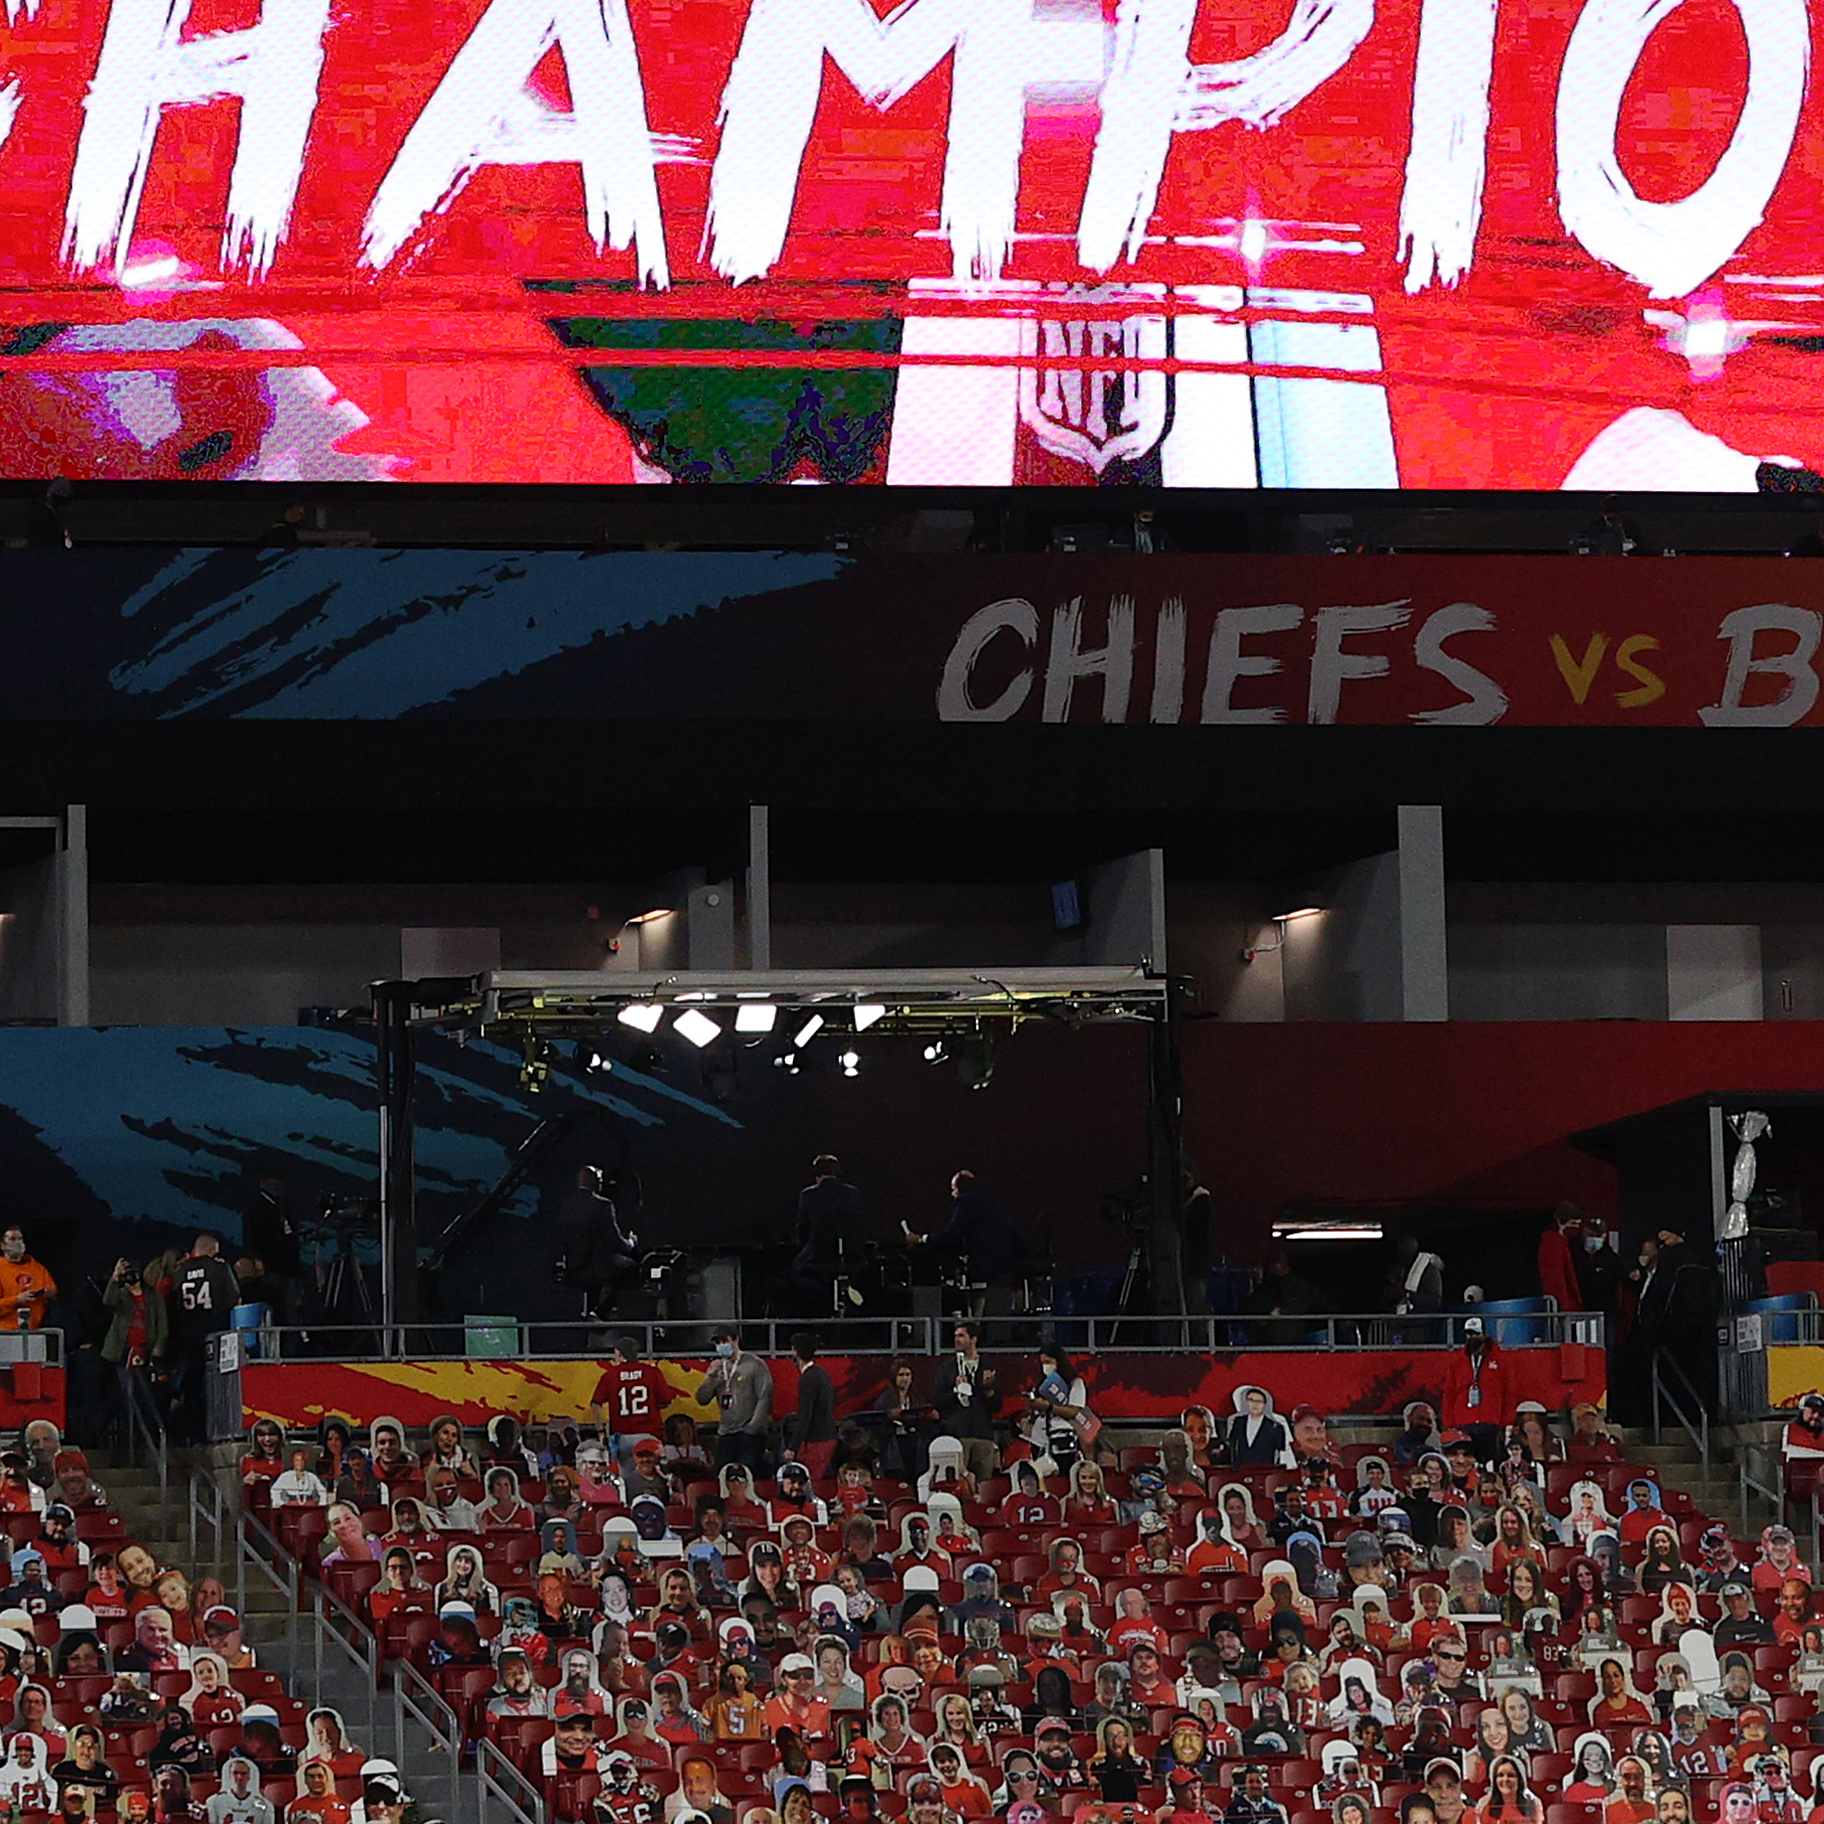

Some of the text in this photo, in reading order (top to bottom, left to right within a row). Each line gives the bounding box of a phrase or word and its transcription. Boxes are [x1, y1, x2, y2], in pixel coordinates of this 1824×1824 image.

[937, 598, 1509, 726] CHIEFS
[182, 1281, 213, 1310] 54
[618, 1385, 649, 1416] 12
[1018, 1506, 1044, 1522] 12
[729, 1706, 745, 1734] 5
[1296, 1698, 1319, 1726] 13
[1679, 1751, 1708, 1774] 12
